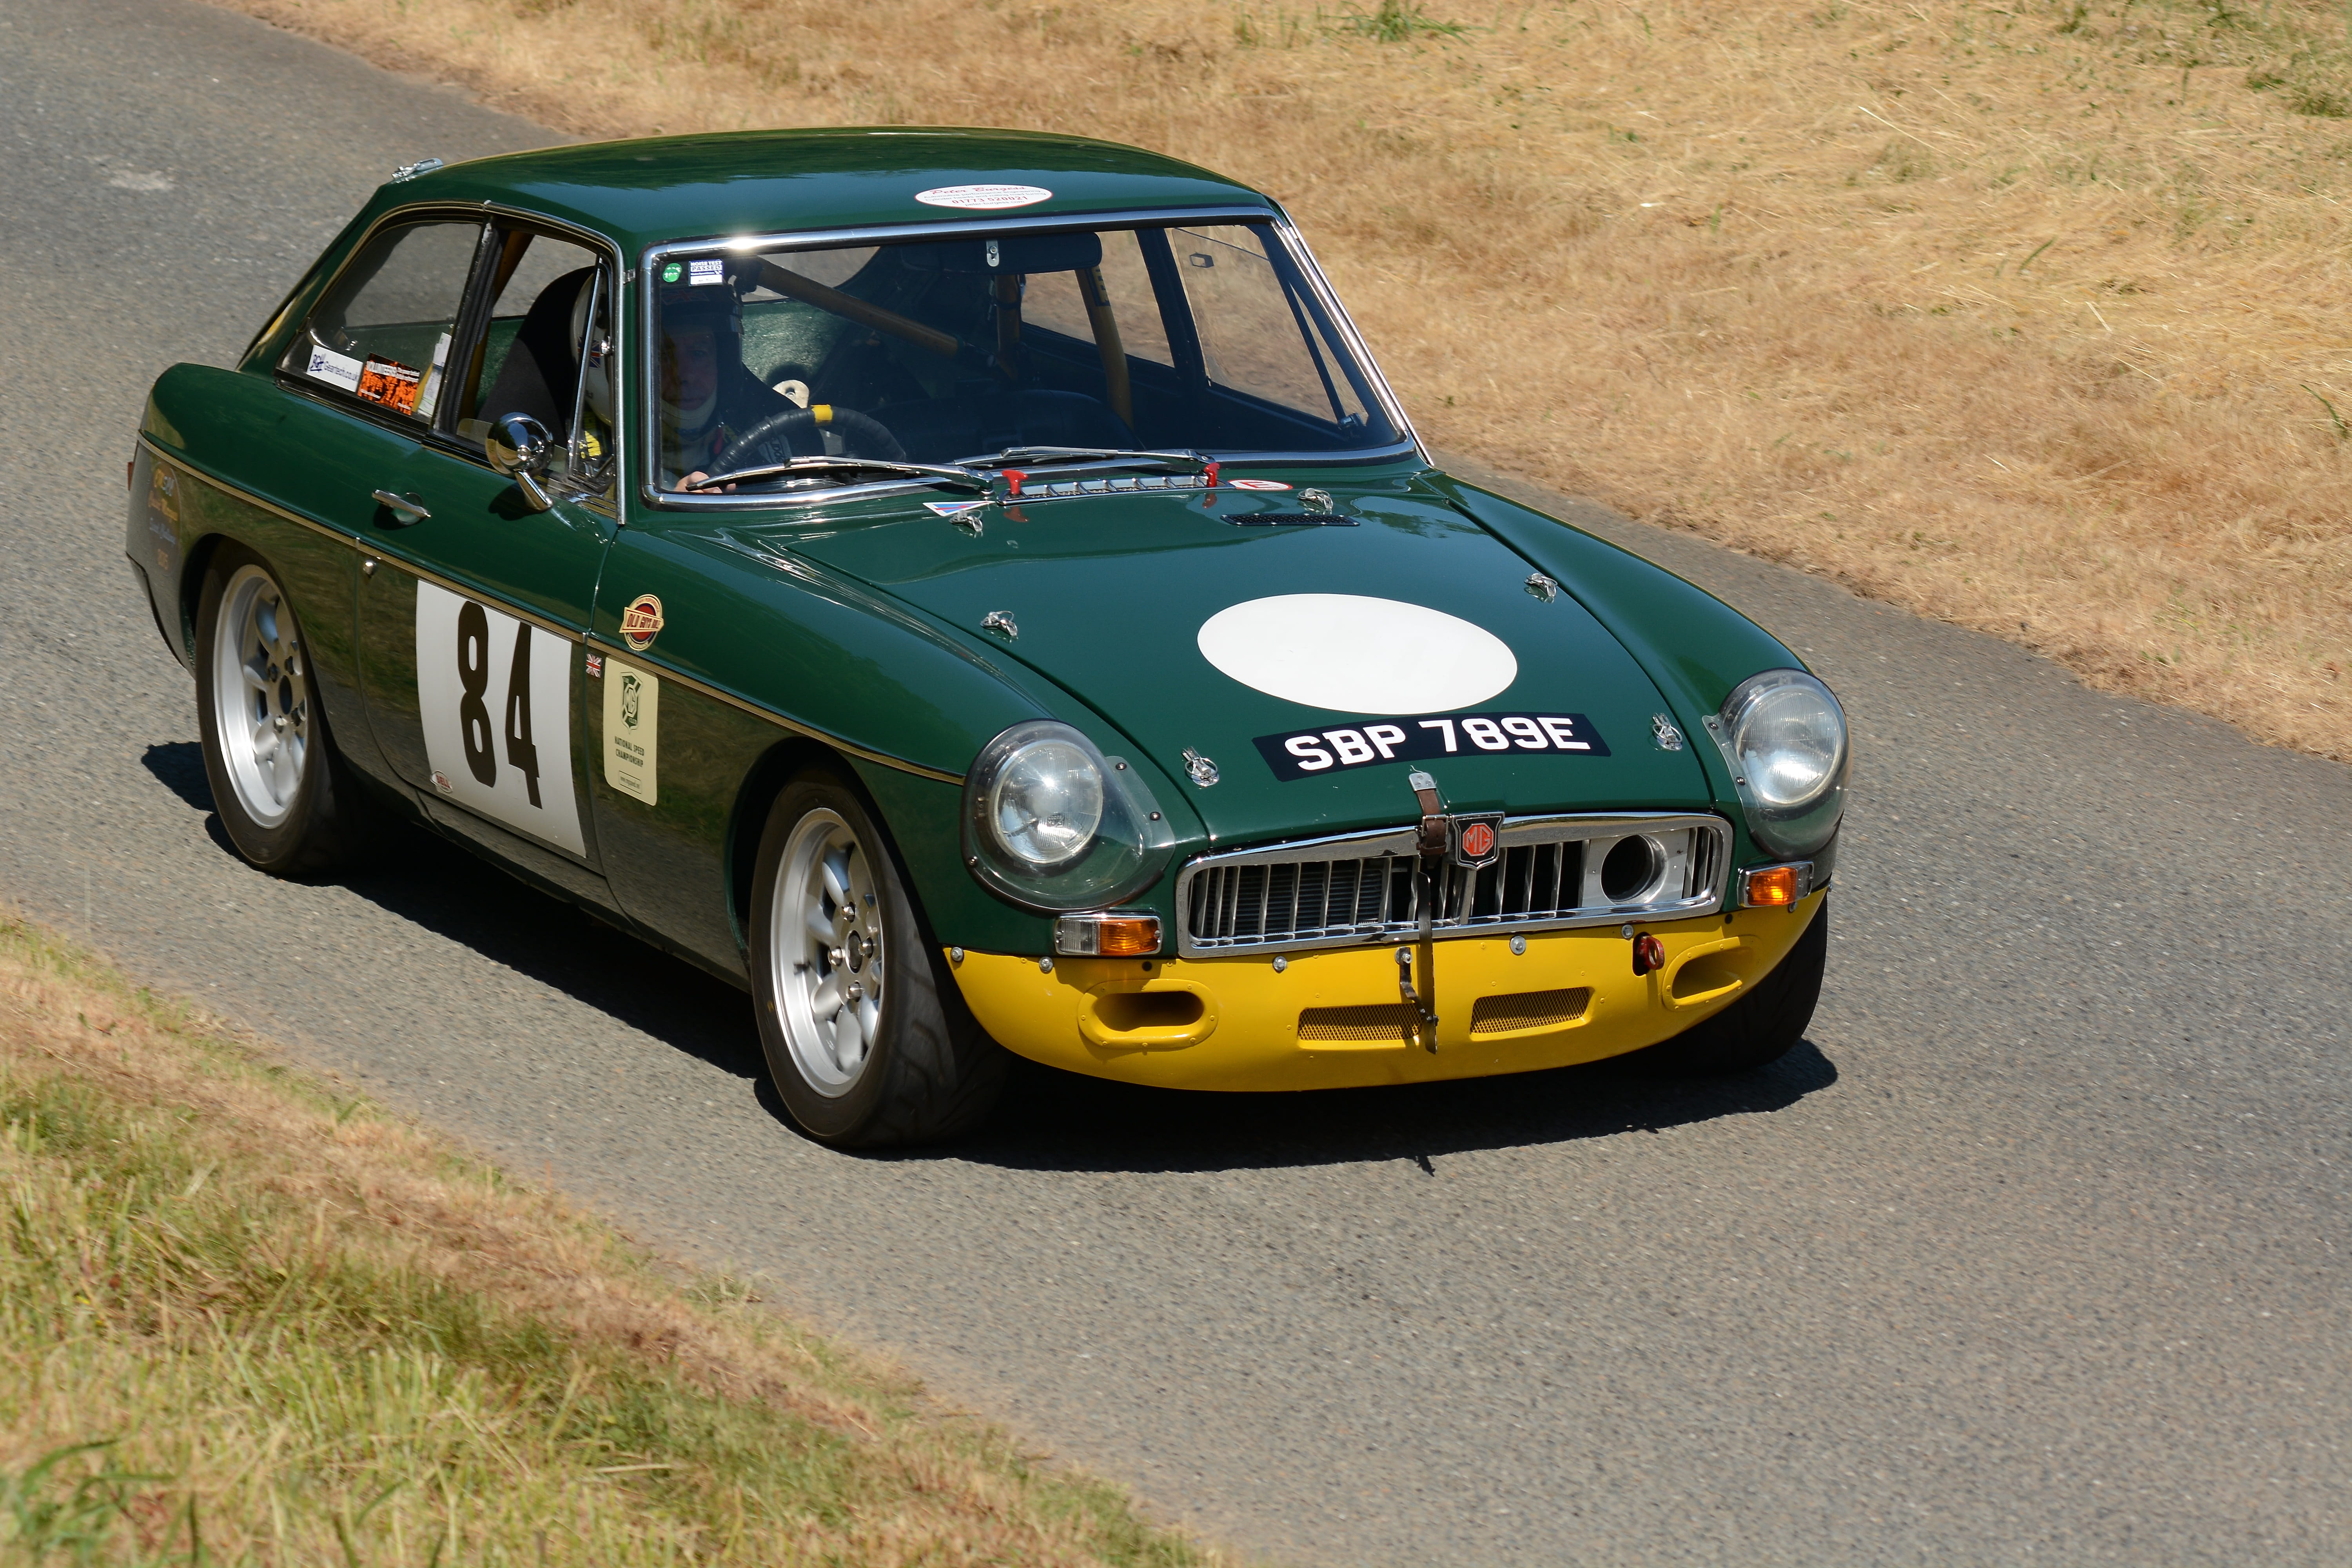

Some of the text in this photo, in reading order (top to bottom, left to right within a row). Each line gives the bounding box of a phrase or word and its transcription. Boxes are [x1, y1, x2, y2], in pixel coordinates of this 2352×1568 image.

[626, 613, 640, 627] OLD
[458, 601, 543, 809] 84
[615, 736, 644, 756] NATIONAL SPEED
[1284, 717, 1591, 771] SBP 789E
[615, 748, 643, 768] CHAMPIONSHIP
[1466, 826, 1490, 854] MG
